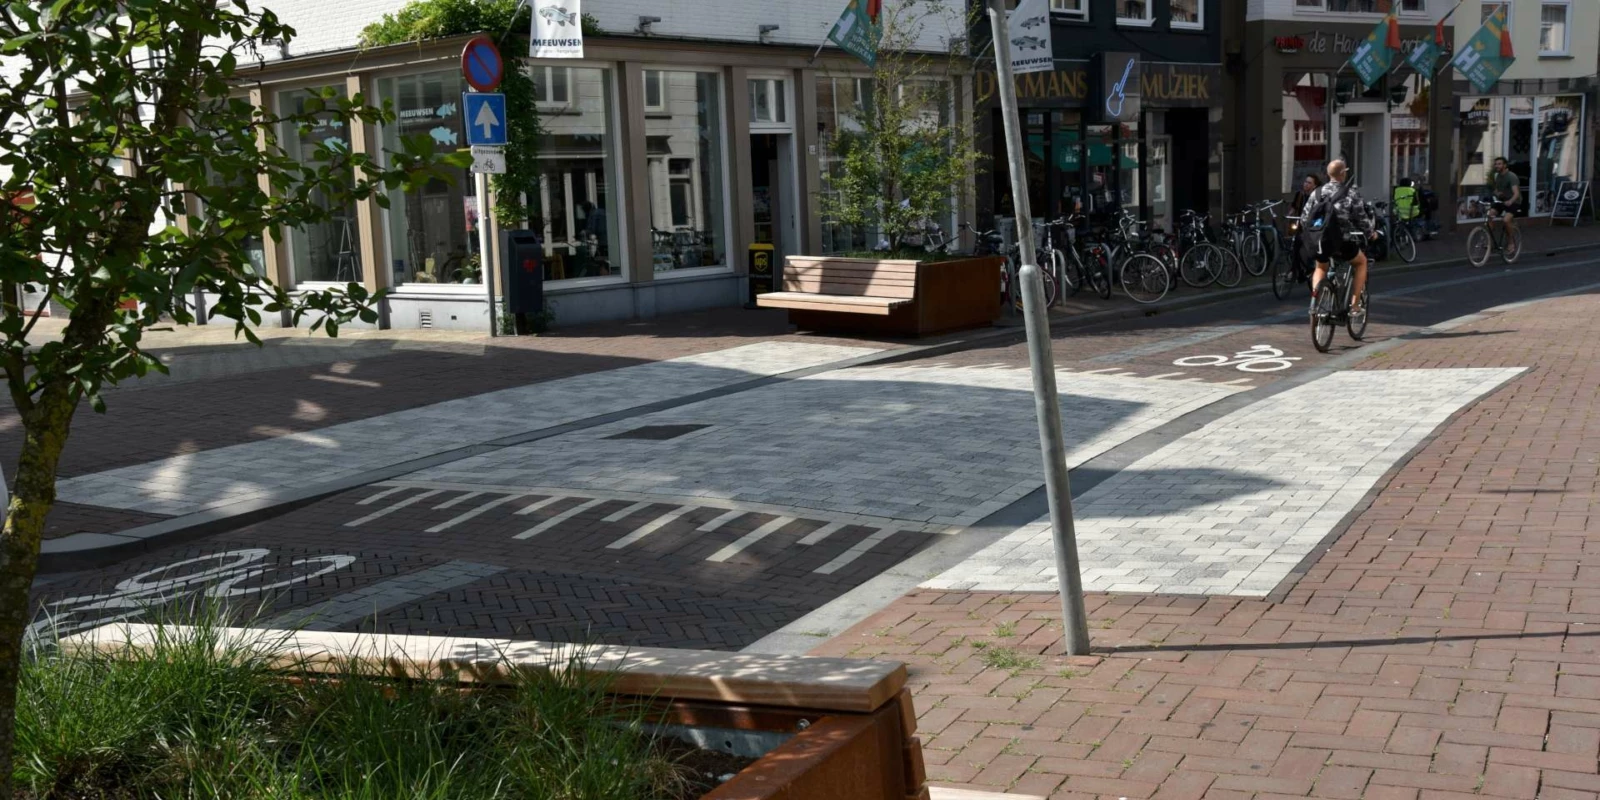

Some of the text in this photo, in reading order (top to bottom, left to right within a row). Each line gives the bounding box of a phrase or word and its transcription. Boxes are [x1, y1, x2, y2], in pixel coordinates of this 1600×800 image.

[532, 38, 582, 47] MEEUWSEN
[1308, 30, 1326, 53] de
[976, 70, 1209, 99] DKMANS MUZIEK
[400, 108, 434, 118] MEEUWSEN
